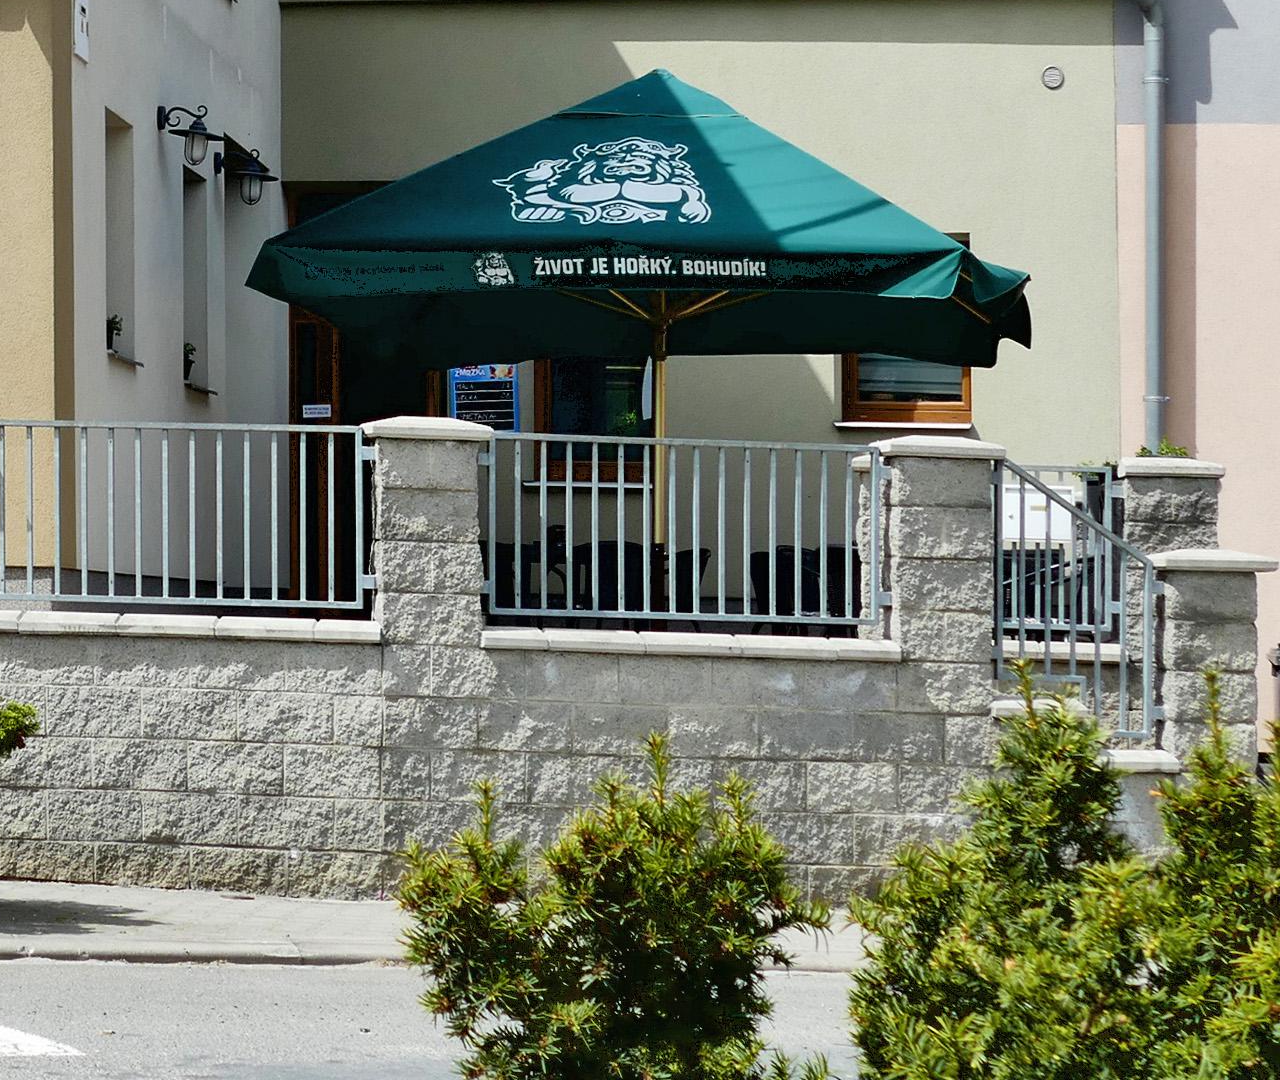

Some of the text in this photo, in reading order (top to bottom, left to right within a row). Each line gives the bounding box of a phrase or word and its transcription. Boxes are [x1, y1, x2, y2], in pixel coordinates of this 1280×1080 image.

[534, 255, 766, 276] ŽIVOT JE HOŘKÝ. BOHUDÍK!
